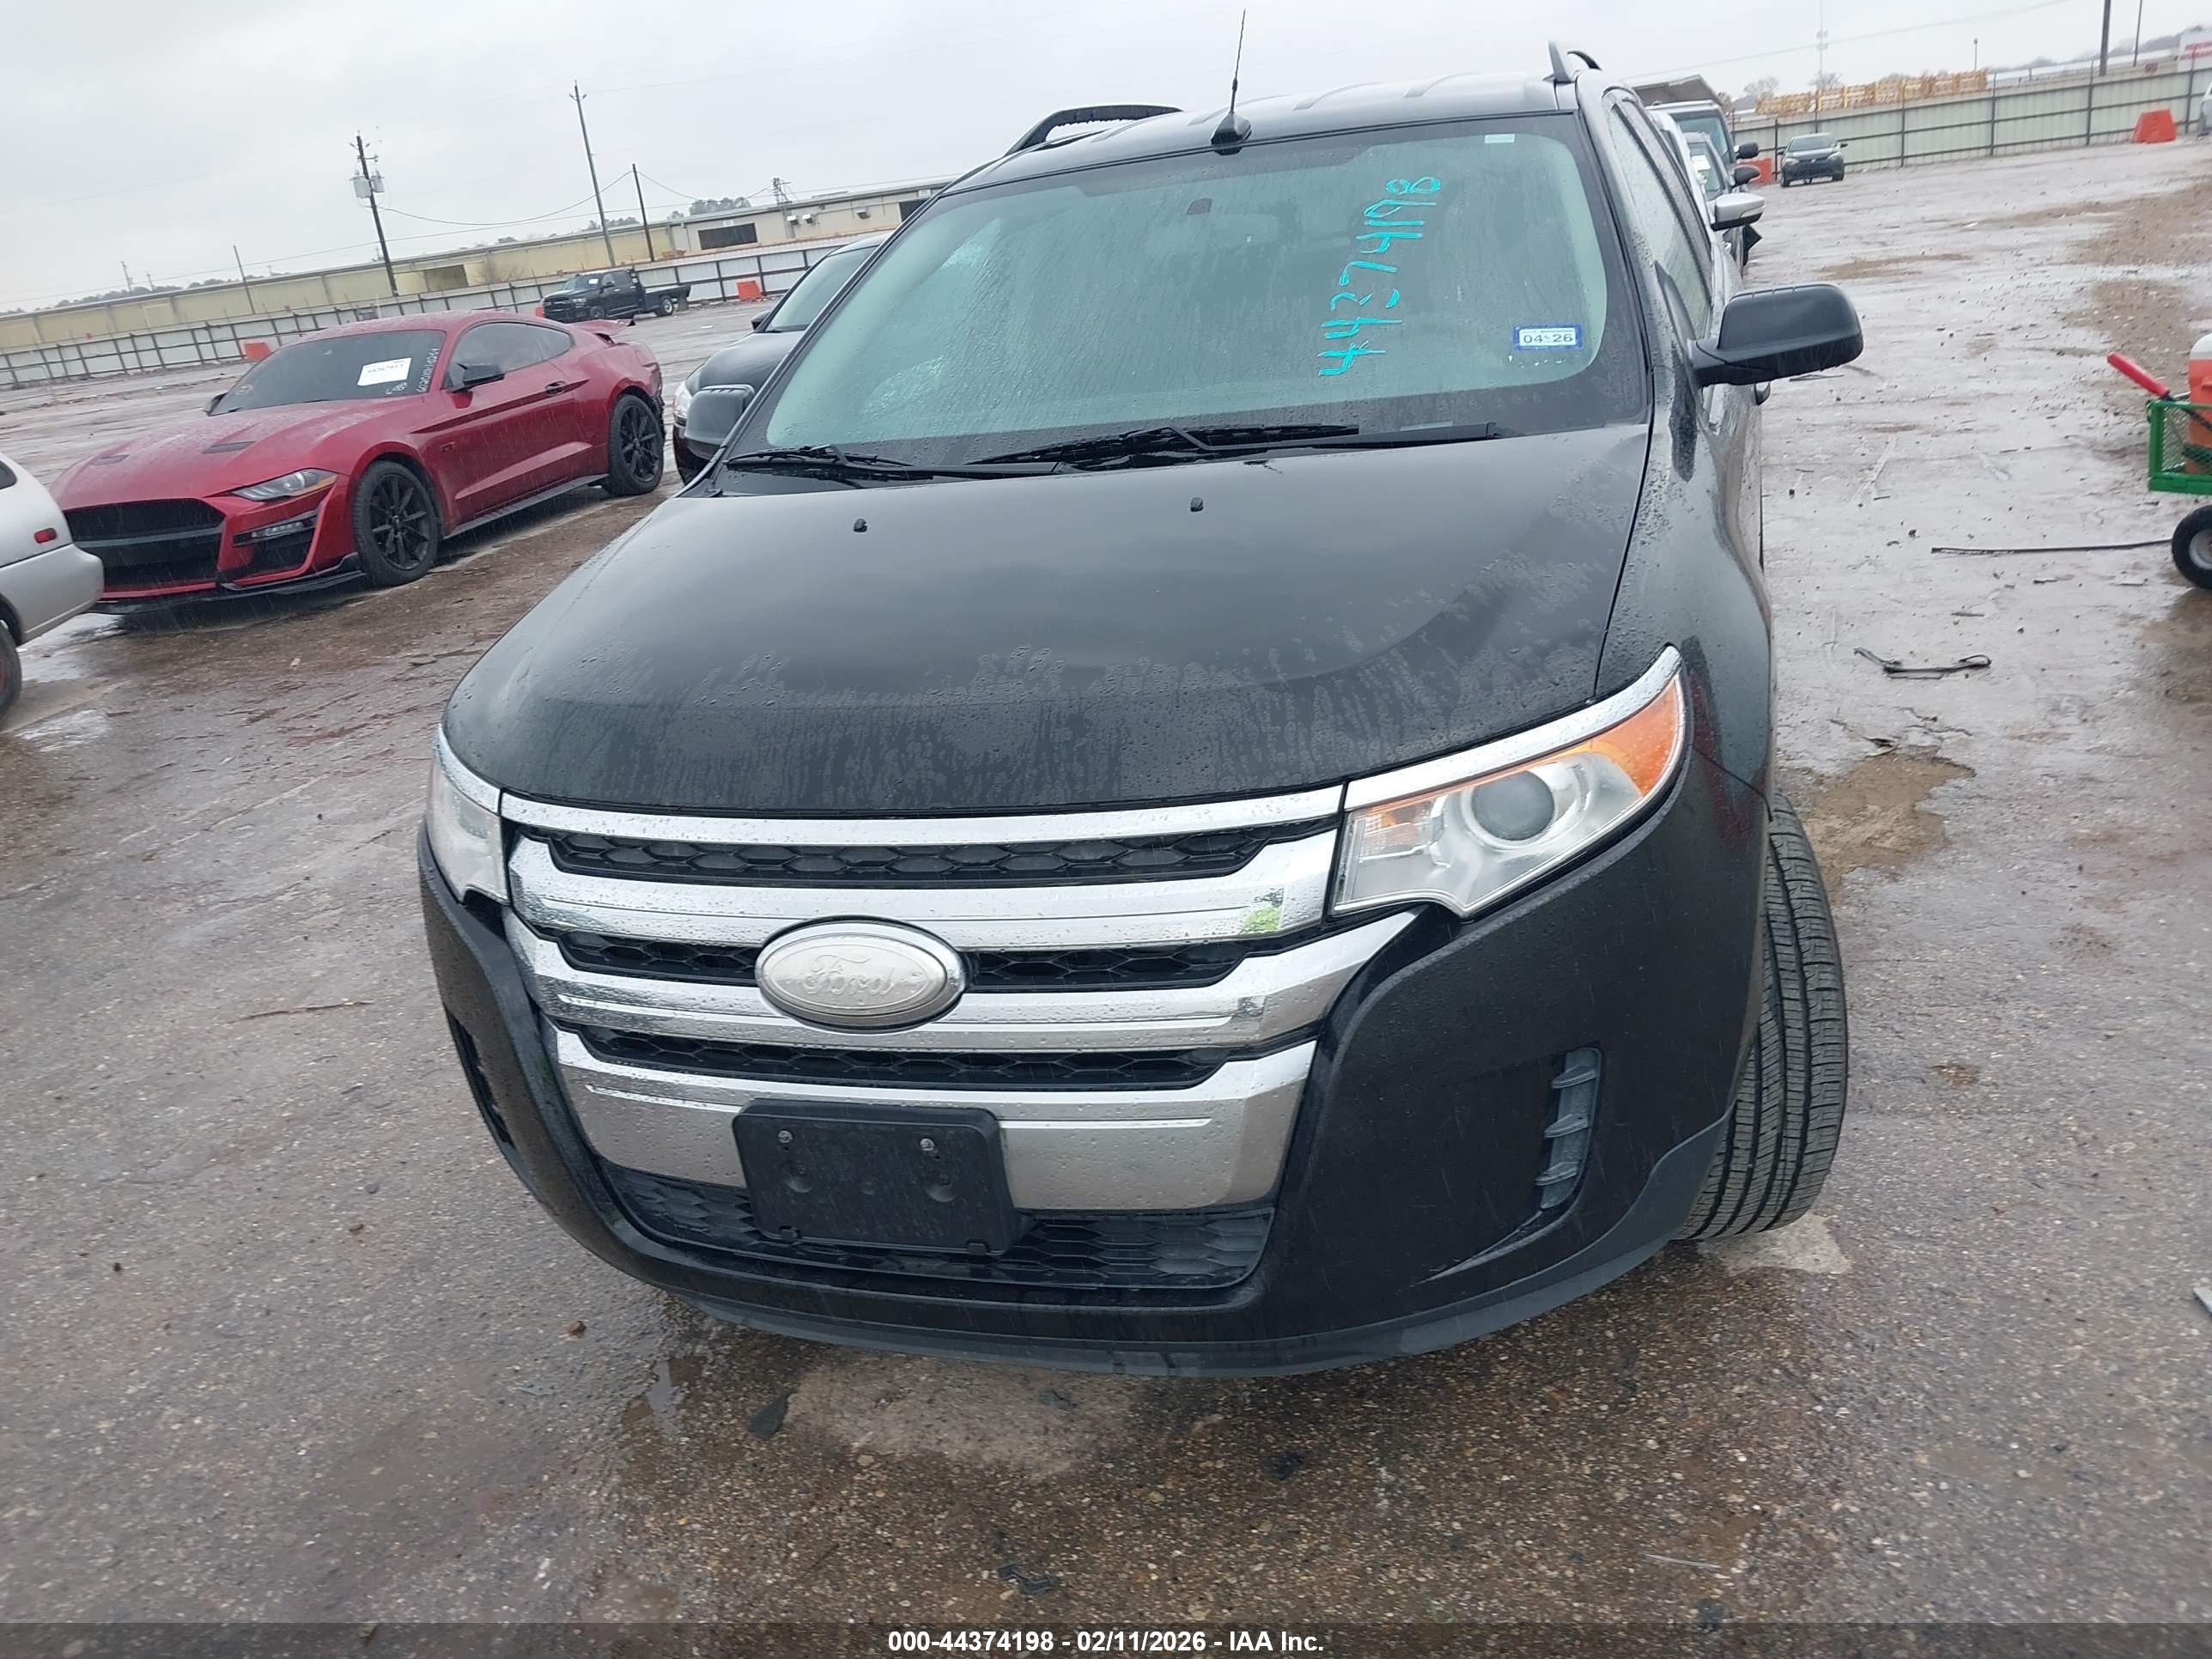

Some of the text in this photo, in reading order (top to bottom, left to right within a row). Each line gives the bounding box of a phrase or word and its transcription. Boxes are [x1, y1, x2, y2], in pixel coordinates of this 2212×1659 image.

[1317, 177, 1441, 376] 44374198
[1523, 333, 1573, 343] 04 26
[803, 954, 896, 996] Ford
